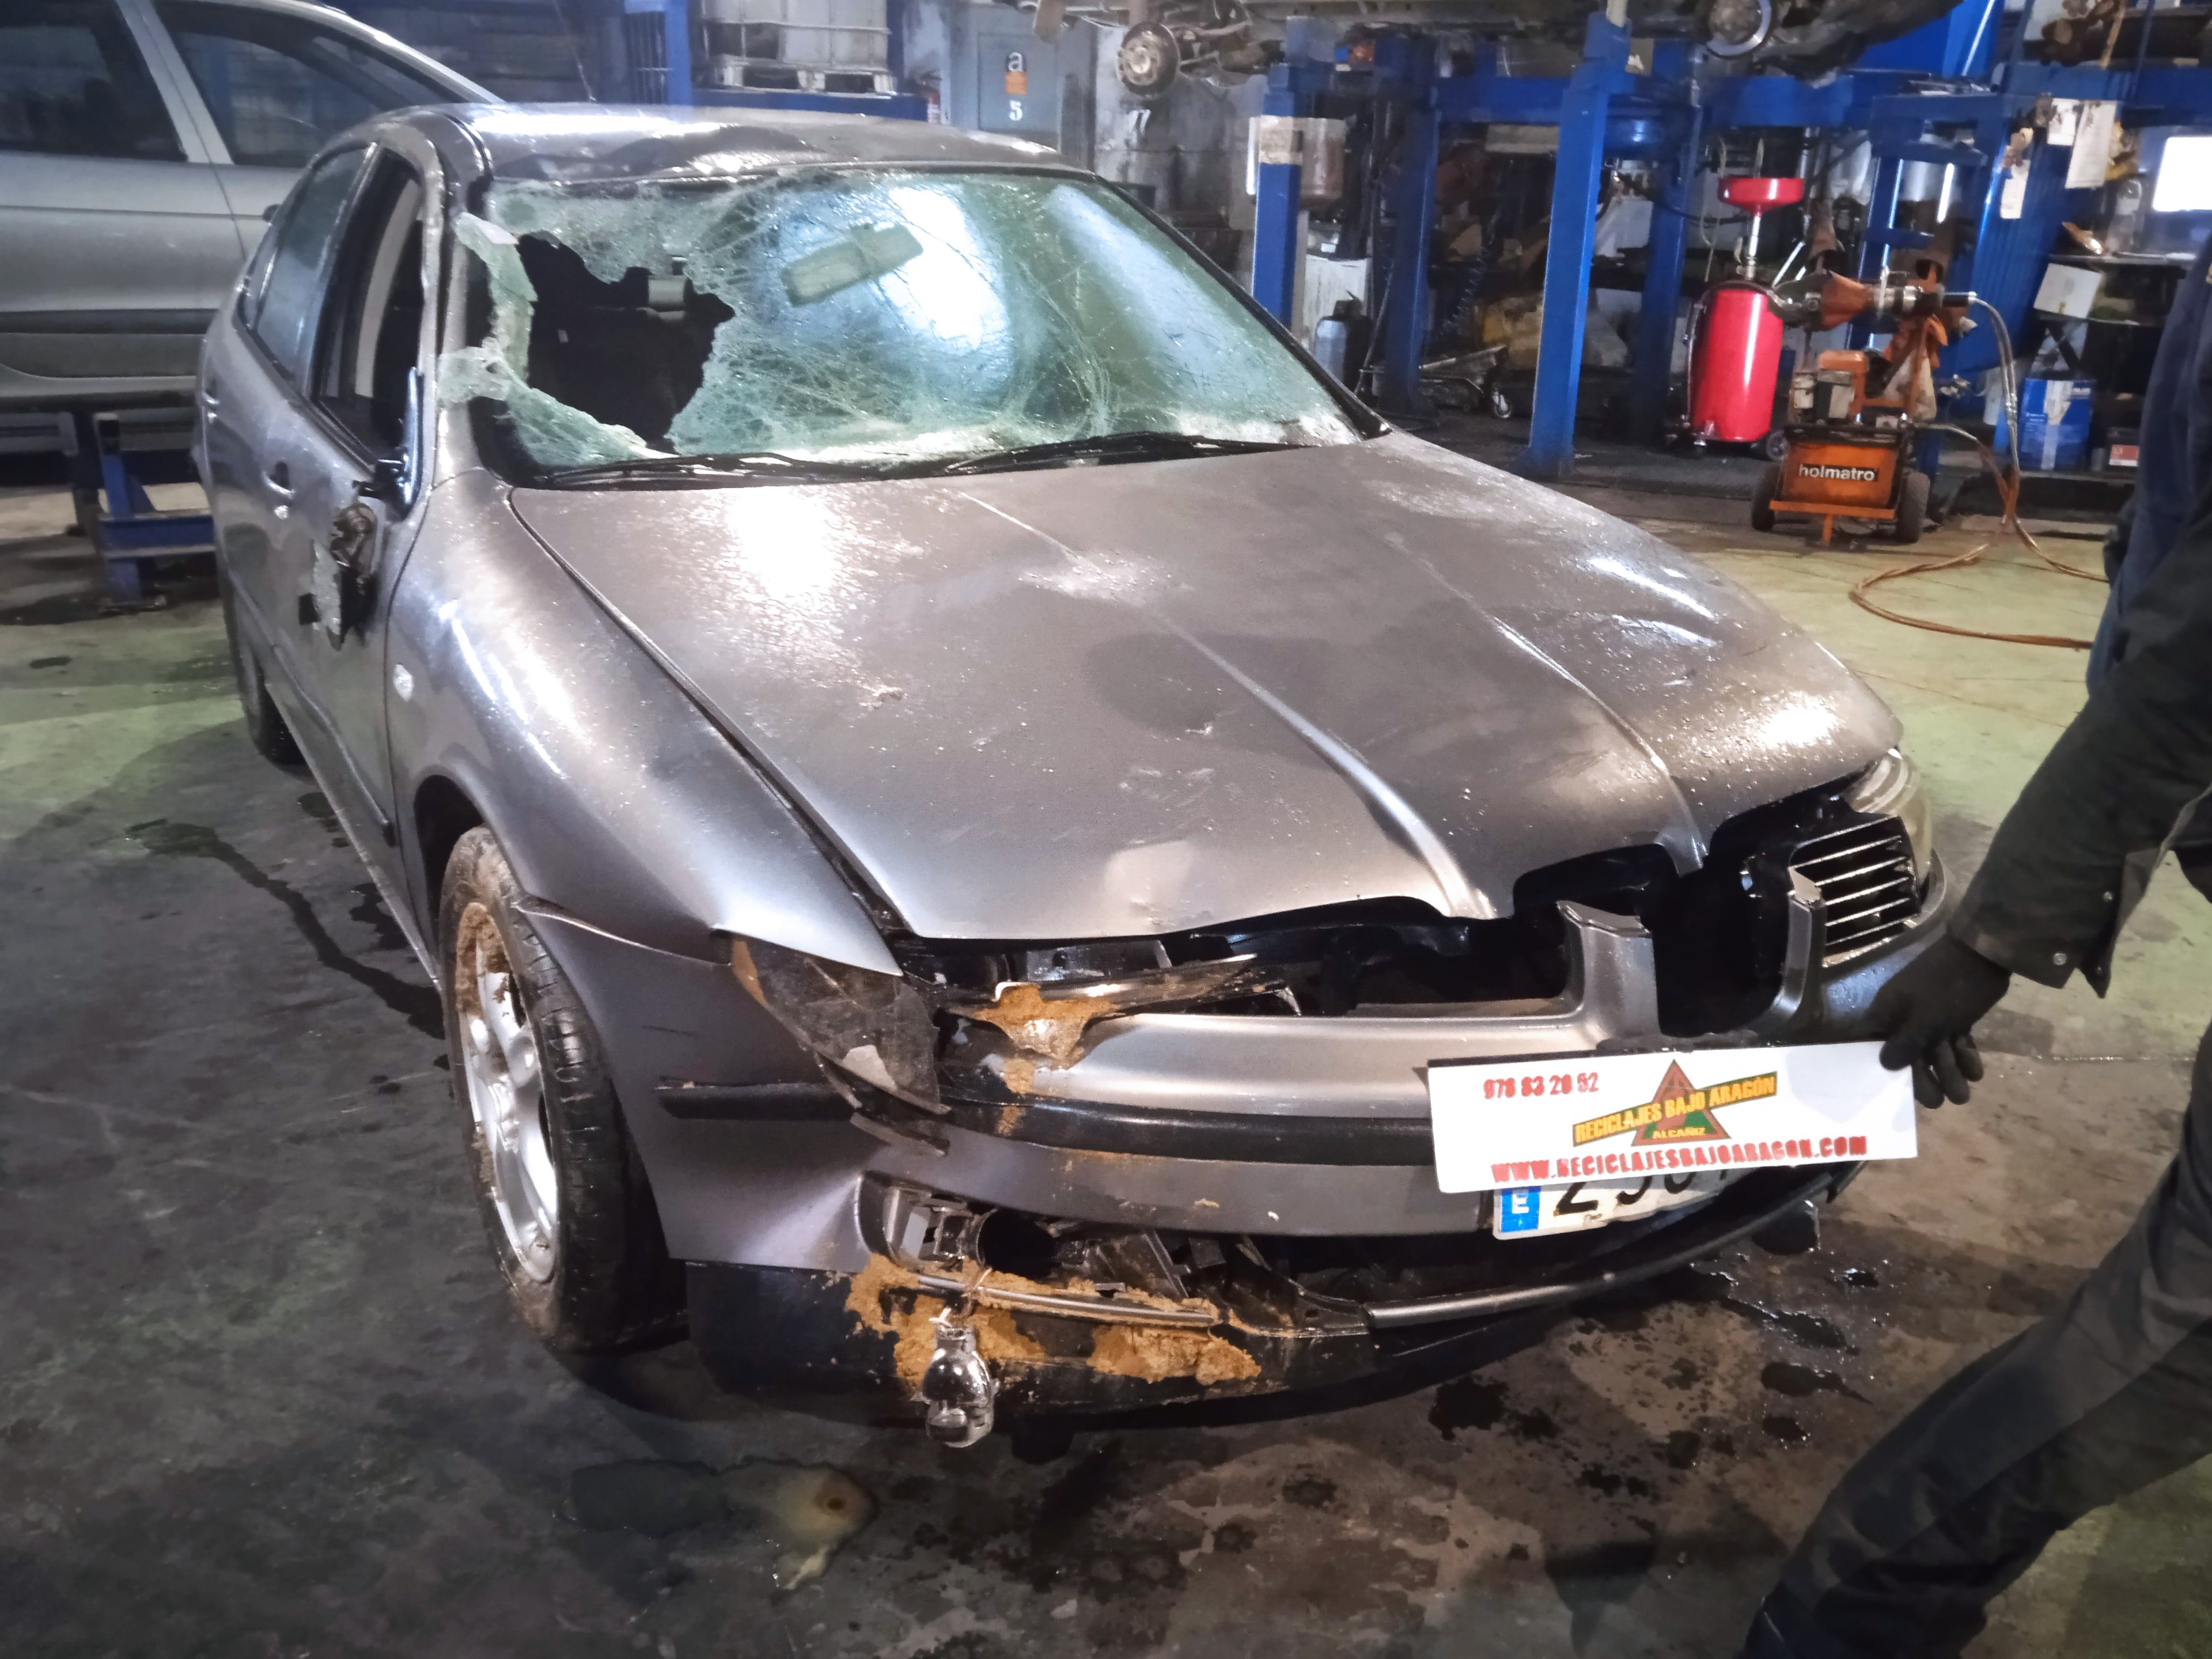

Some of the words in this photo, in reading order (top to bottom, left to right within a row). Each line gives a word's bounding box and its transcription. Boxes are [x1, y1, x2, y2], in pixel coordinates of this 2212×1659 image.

[1009, 100, 1023, 120] 5
[1799, 464, 1874, 481] holmatro
[1483, 1077, 1516, 1100] 978
[1575, 1103, 1662, 1143] RECICLAJES
[1665, 1092, 1706, 1118] BAJO
[1709, 1076, 1775, 1107] ARAGÓN
[1491, 1136, 1868, 1183] WWW.RECICLAJESBAJOARAGON.COM
[1512, 1188, 1530, 1214] E
